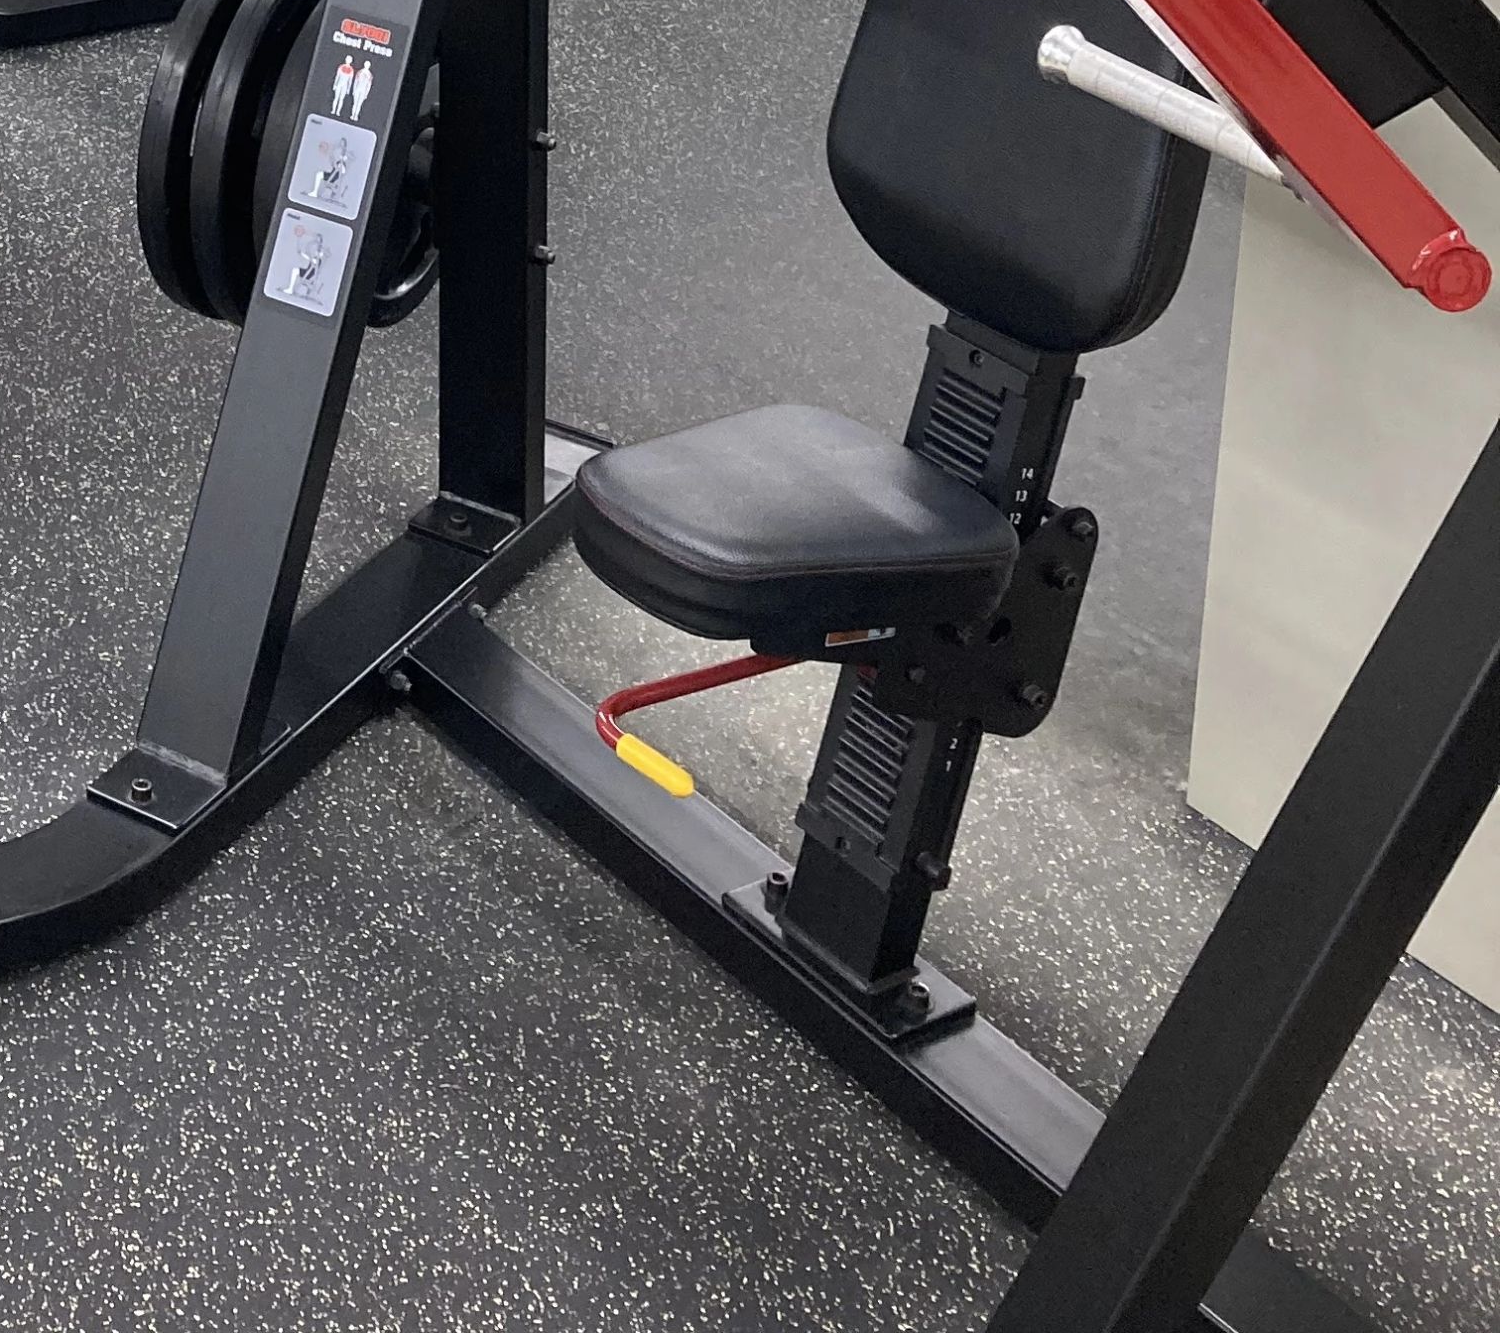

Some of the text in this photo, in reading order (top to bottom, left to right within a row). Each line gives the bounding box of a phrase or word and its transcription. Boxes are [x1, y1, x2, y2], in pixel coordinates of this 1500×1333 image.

[333, 30, 393, 58] Chest Press
[1021, 467, 1034, 480] 14
[1015, 489, 1028, 502] 13
[1010, 512, 1022, 525] 12
[950, 737, 958, 750] 2
[946, 760, 952, 772] 1
